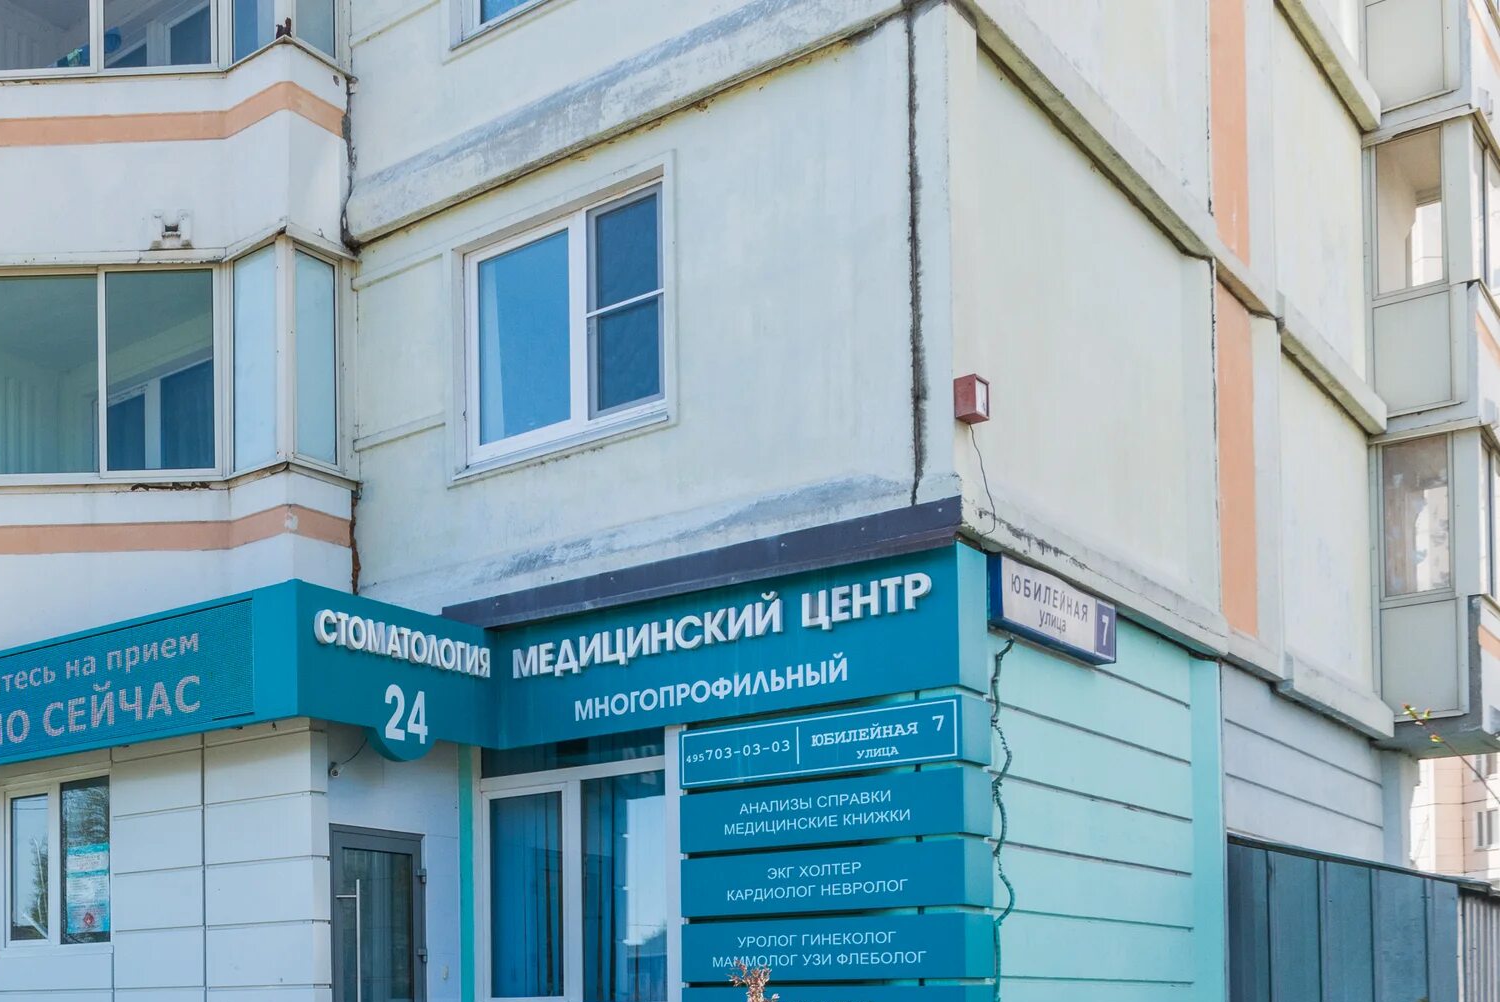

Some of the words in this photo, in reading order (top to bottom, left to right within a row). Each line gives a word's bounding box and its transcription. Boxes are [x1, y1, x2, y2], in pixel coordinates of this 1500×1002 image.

[1011, 573, 1088, 623] ЮБИЛЕЙНАЯ
[512, 590, 783, 679] МЕДИЦИНСКИЙ
[801, 572, 932, 631] ЦЕНТР
[1039, 609, 1067, 634] улица
[1101, 614, 1110, 647] 7
[65, 654, 97, 680] на
[106, 631, 199, 673] прием
[314, 608, 491, 678] СТОМАТОЛОГИЯ
[574, 651, 848, 722] МНОГОПРОФИЛЬНЫЙ
[43, 674, 201, 736] СЕЙЧАС
[384, 684, 429, 745] 24
[811, 721, 918, 747] ЮБИЛЕЙНАЯ
[931, 714, 945, 732] 7
[856, 745, 899, 760] УЛИЦА
[739, 797, 812, 815] АНАЛИЗЫ
[817, 789, 892, 808] СПРАВКИ
[724, 814, 838, 836] МЕДИЦИНСКИЕ
[843, 808, 911, 826] КНИЖКИ
[767, 866, 795, 880] ЭКГ
[799, 861, 862, 878] ХОЛТЕР
[727, 884, 816, 902] КАРДИОЛОГ
[821, 878, 909, 896] НЕВРОЛОГ
[737, 934, 797, 949] УРОЛОГ
[802, 931, 897, 946] ГИНЕКОЛОГ
[712, 954, 798, 968] МАММОЛОГ
[803, 952, 833, 967] УЗИ
[836, 950, 927, 965] ФЛЕБОЛОГ
